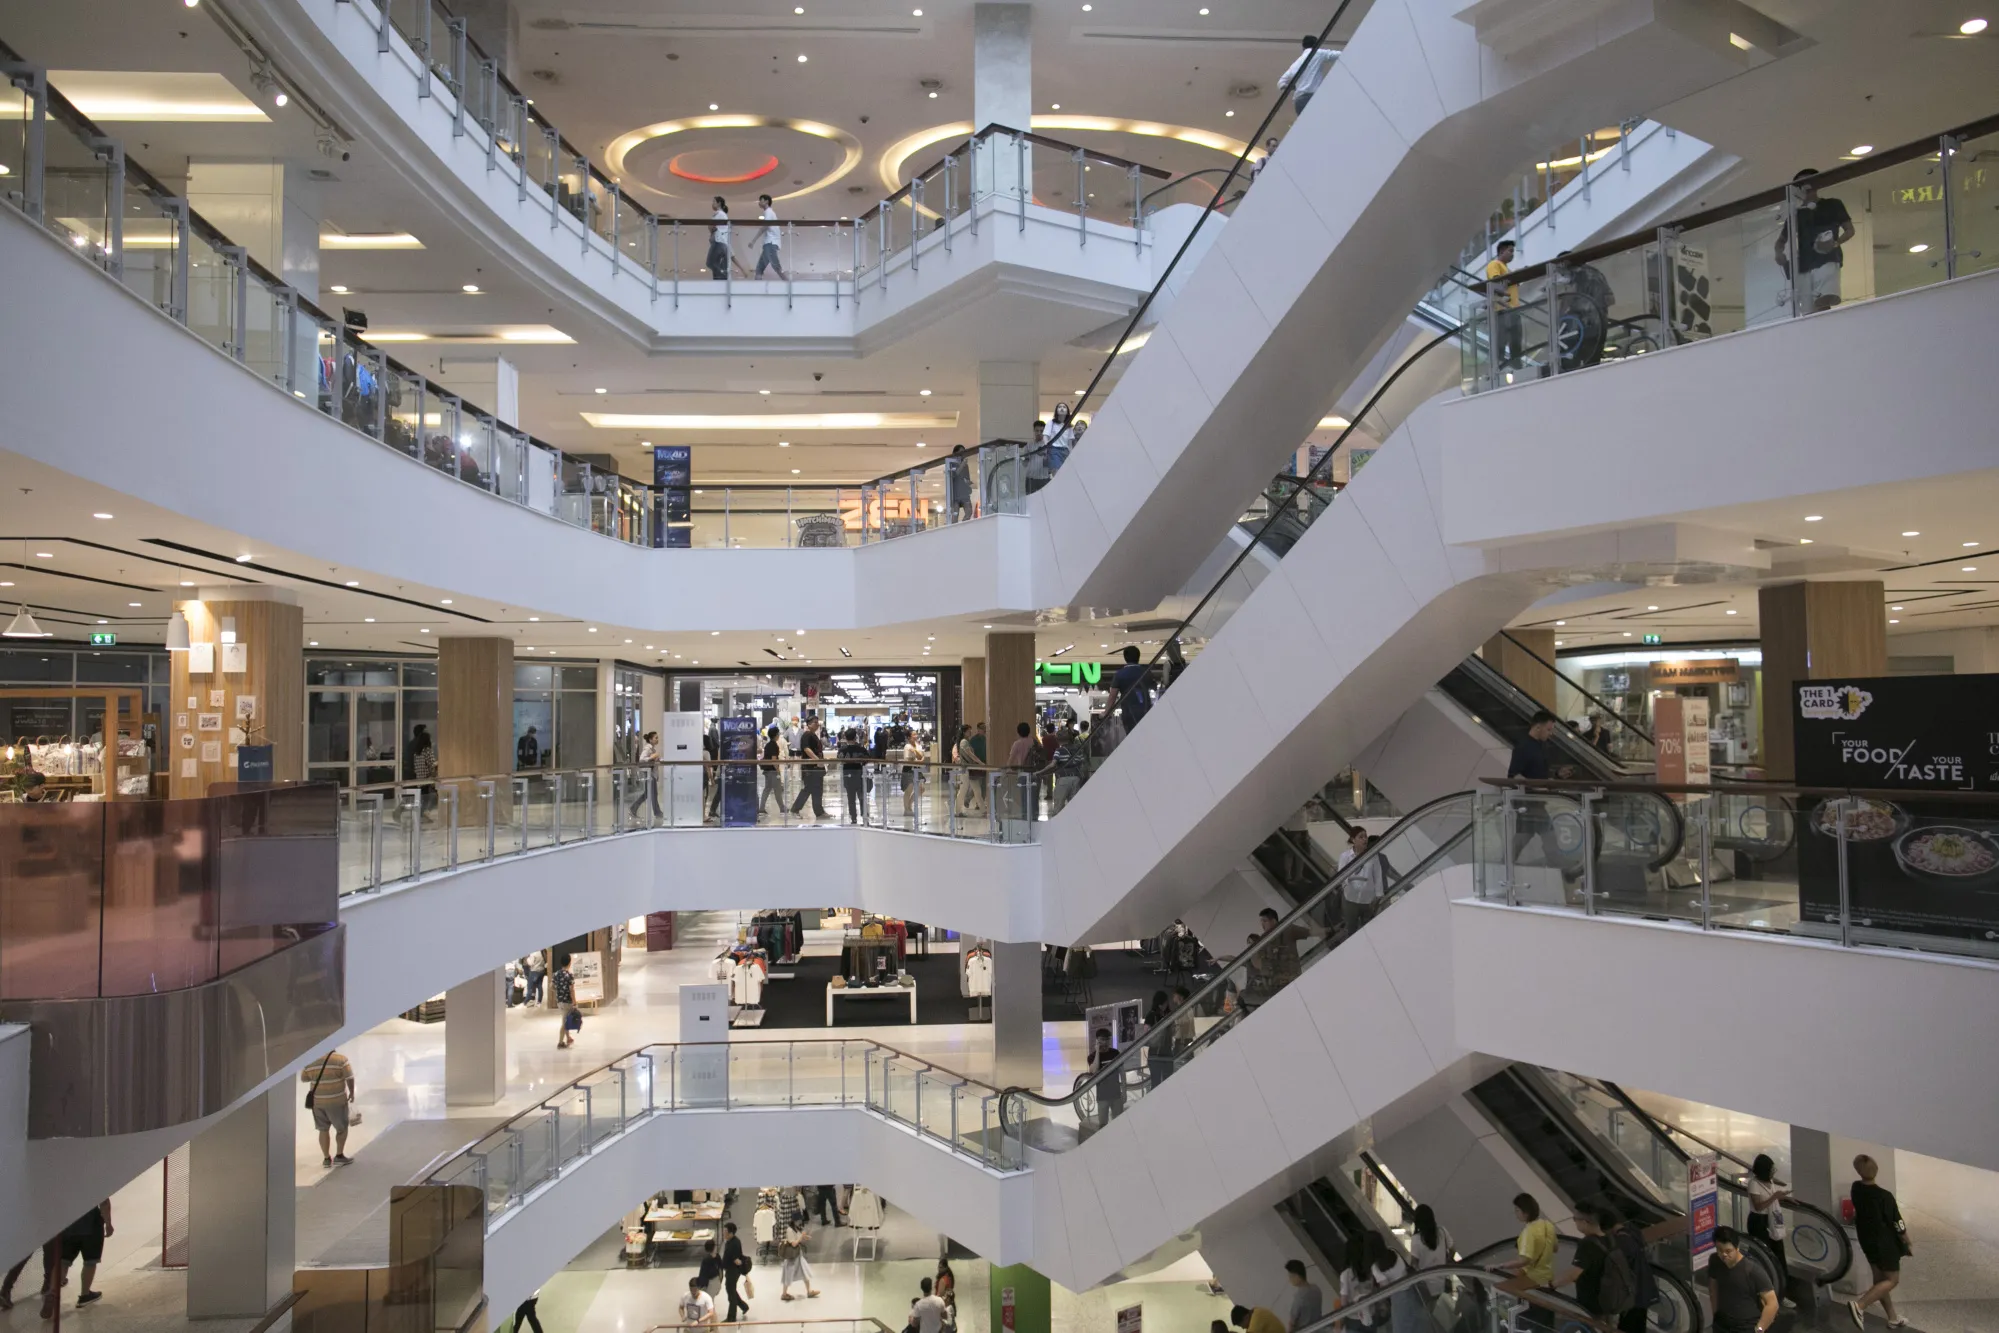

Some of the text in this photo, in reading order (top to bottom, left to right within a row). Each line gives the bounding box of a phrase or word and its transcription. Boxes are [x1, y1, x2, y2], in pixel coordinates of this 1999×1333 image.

[1803, 690, 1823, 698] THE
[1803, 700, 1834, 708] CARD
[1659, 738, 1682, 754] 70%
[1841, 740, 1869, 748] YOUR
[1842, 748, 1902, 764] FOOD
[1932, 756, 1963, 764] YOUR
[1896, 764, 1964, 781] TASTE
